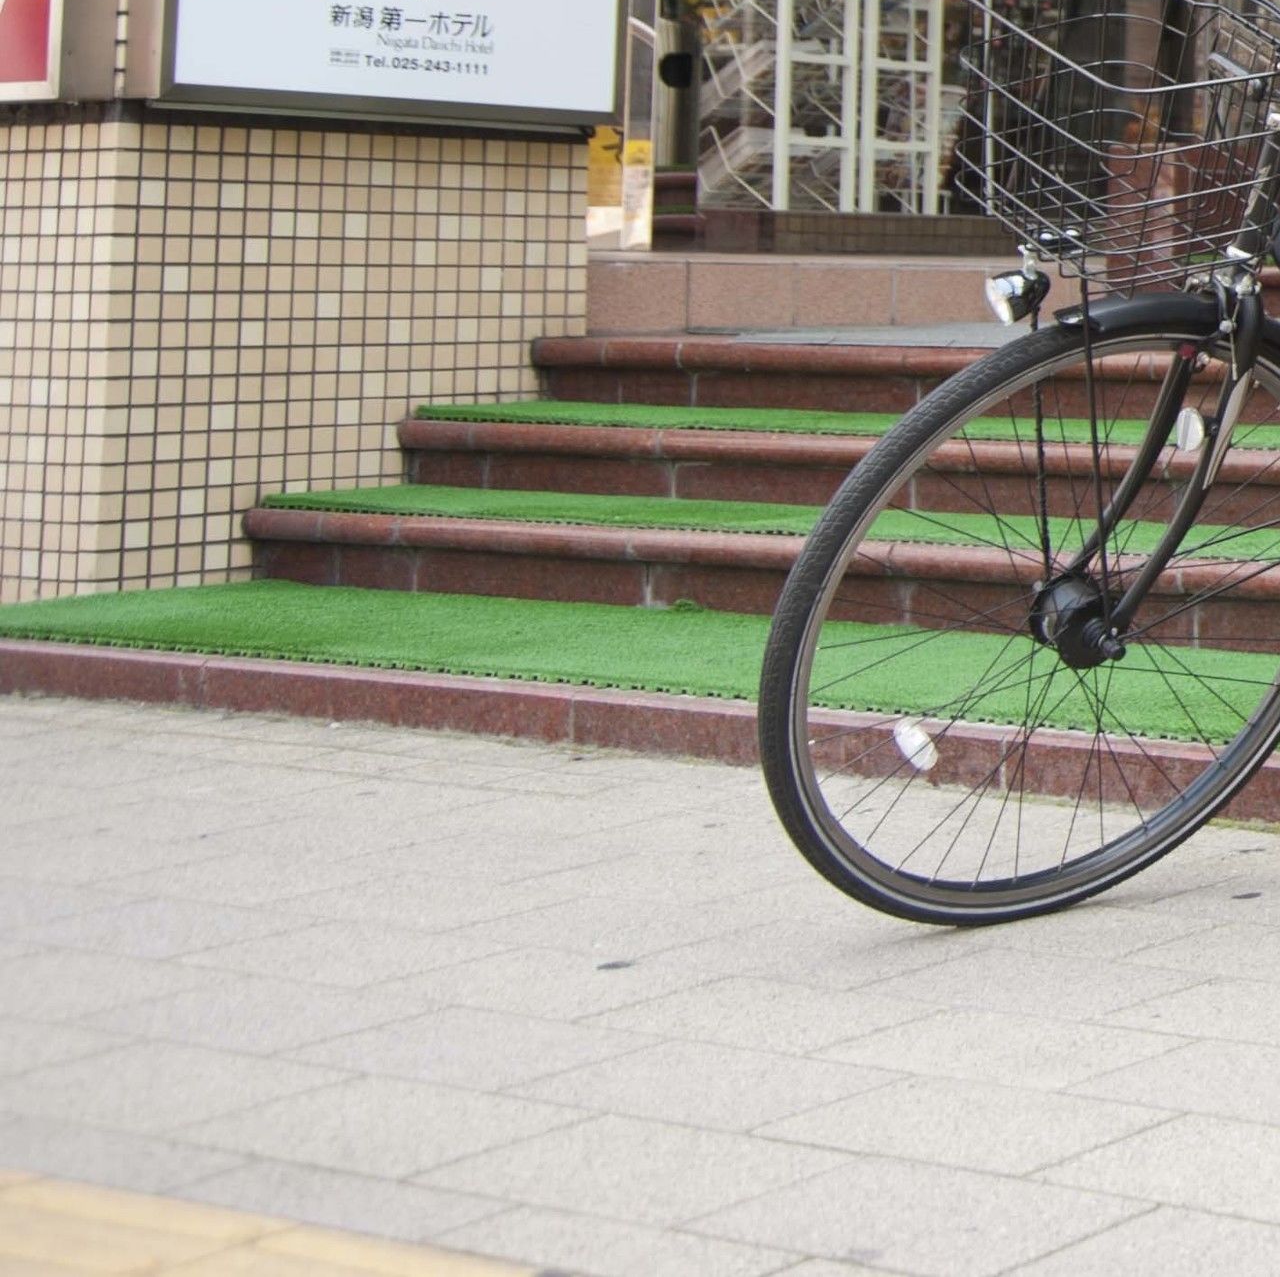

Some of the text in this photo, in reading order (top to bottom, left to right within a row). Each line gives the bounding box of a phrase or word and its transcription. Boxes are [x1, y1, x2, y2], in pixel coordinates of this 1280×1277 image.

[329, 4, 493, 38] 新潟第一ホテル
